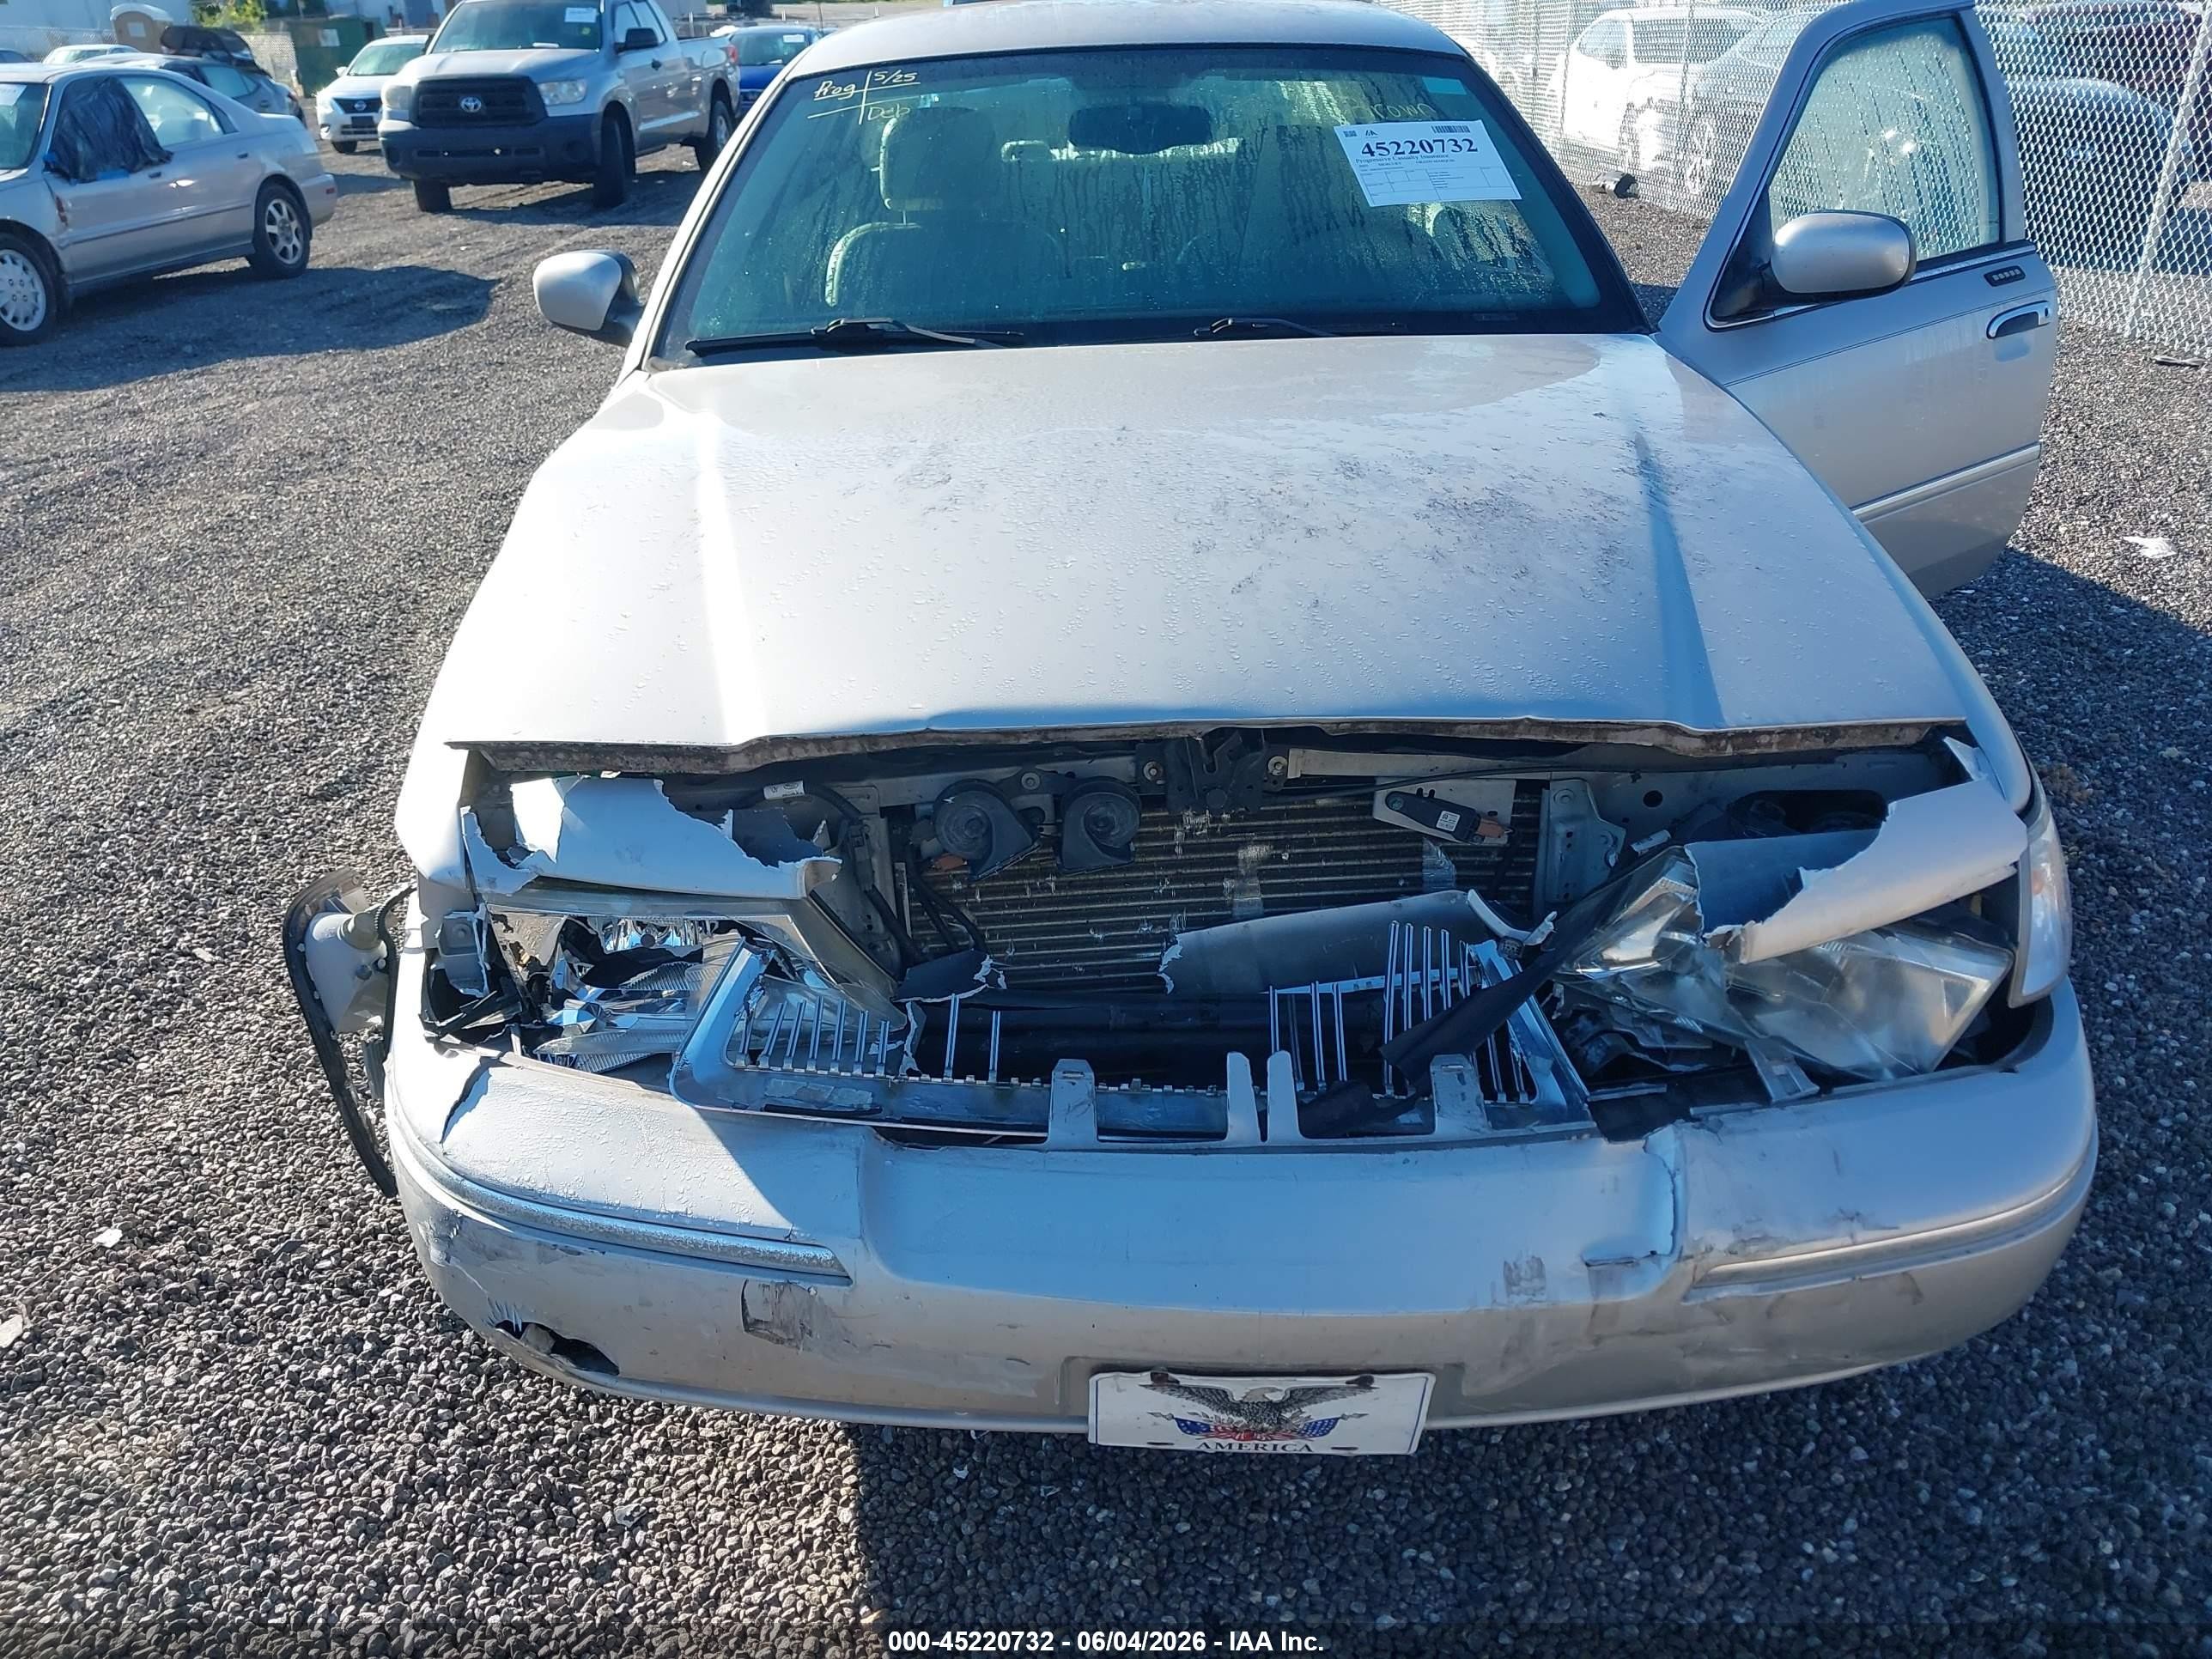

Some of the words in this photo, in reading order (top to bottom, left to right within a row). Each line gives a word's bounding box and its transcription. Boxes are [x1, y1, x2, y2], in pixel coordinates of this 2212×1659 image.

[874, 70, 918, 84] 5/25
[1361, 138, 1478, 157] 45220732
[1195, 1442, 1313, 1452] AMERICA
